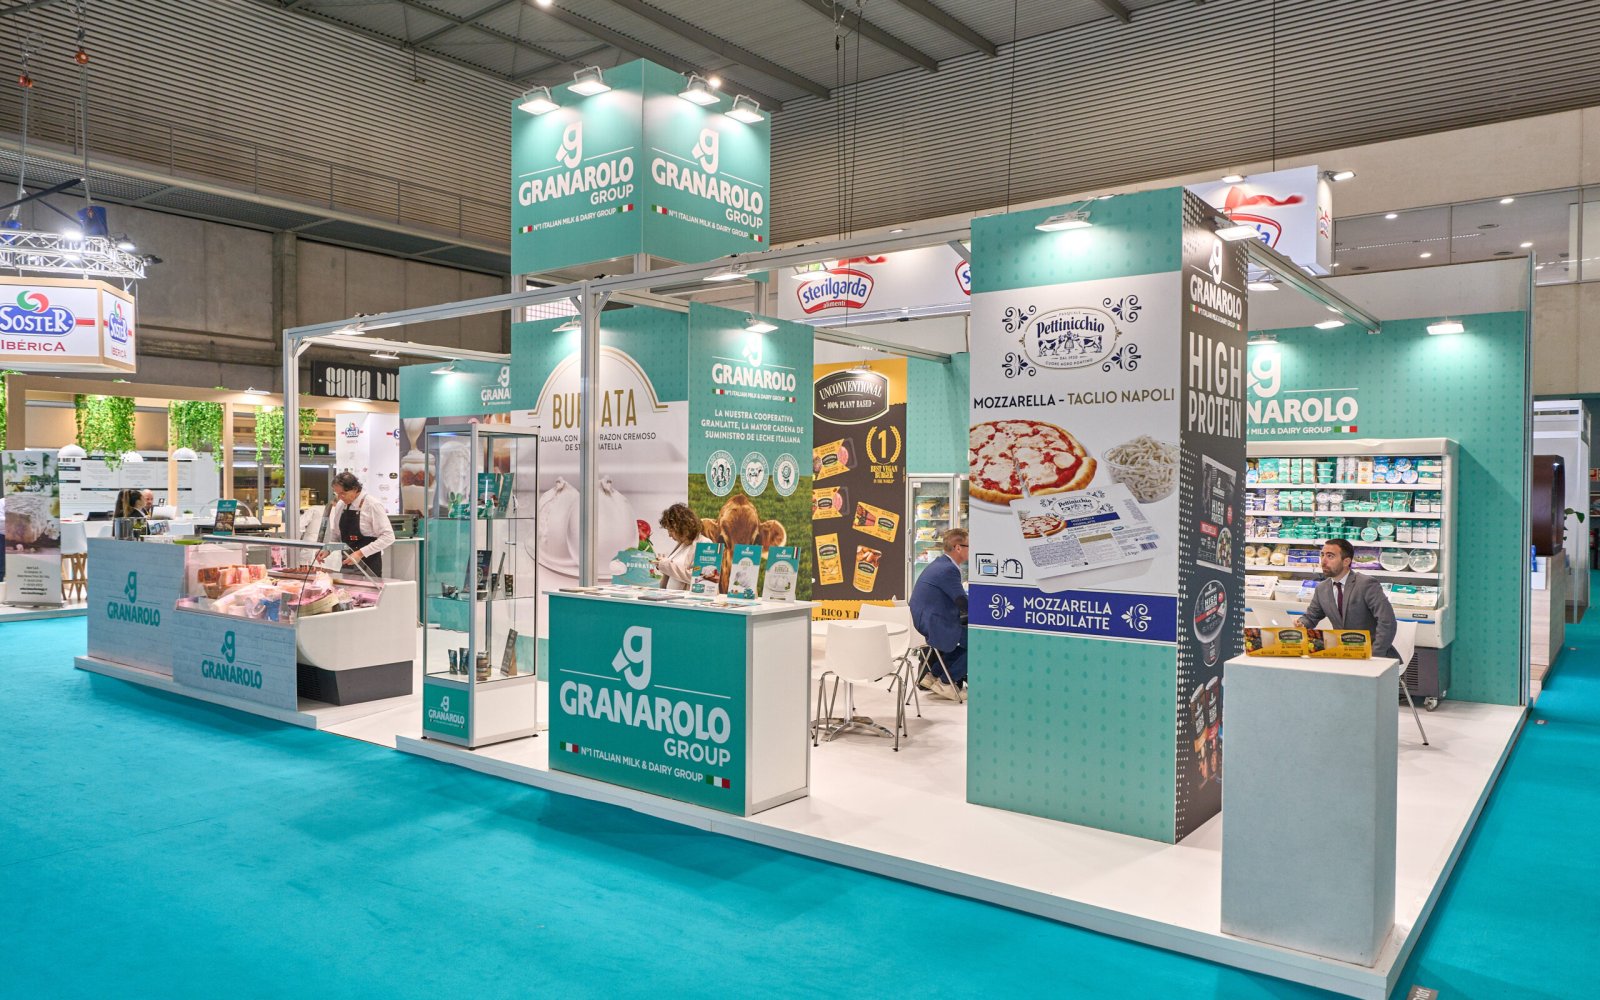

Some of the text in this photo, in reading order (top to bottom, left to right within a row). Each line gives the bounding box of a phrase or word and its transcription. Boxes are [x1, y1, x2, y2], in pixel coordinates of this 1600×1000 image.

[519, 156, 634, 206] GRANAROLO
[651, 157, 763, 214] GRANAROLO
[590, 183, 634, 205] GROUP
[542, 218, 562, 229] ITALIAN
[562, 215, 575, 225] MILK
[580, 211, 596, 221] DAIRY
[596, 207, 617, 217] GROUP
[678, 212, 699, 224] ITALIAN
[699, 218, 711, 228] MILK
[716, 223, 731, 233] DAIRY
[731, 228, 749, 238] GROUP
[725, 208, 763, 229] GROUP
[802, 277, 867, 304] sterilgarda
[1190, 274, 1242, 320] GRANAROLO
[823, 300, 846, 309] alimenti
[1036, 315, 1105, 338] Pettinicchio
[1188, 331, 1242, 399] HIGH
[712, 363, 796, 392] GRANAROLO
[481, 388, 511, 401] GRANA
[819, 380, 882, 400] UNCONVENTIONAL
[973, 394, 1056, 409] MOZZARELLA
[1067, 391, 1117, 405] TAGLIO
[1121, 388, 1175, 403] NAPOLI
[553, 389, 637, 429] BUATA
[840, 401, 855, 409] PLANT
[856, 400, 872, 408] BASED
[1188, 390, 1241, 438] PROTEIN
[1247, 396, 1358, 424] NAROLO
[701, 419, 740, 430] GRANLATTE,
[750, 423, 772, 431] MAYOR
[772, 425, 795, 434] CADENA
[796, 426, 804, 434] DE
[714, 409, 794, 423] LA NUESTRA COOPERATIVA
[564, 434, 578, 442] CON
[623, 432, 657, 440] CREMOSO
[705, 430, 801, 443] SUMINISTRO DE LECHE ITALIANA
[1270, 427, 1276, 435] &
[1302, 426, 1331, 434] GROUP
[565, 443, 573, 451] DE
[878, 430, 887, 458] 1
[1211, 499, 1224, 516] HIGH
[107, 602, 160, 627] GRANAROLO
[821, 608, 842, 617] RICO
[845, 610, 851, 619] Y
[1023, 596, 1112, 615] MOZZARELLA
[1025, 612, 1110, 630] FIORDILATTE
[201, 660, 262, 689] GRANAROLO
[428, 709, 465, 725] GRANAROLO
[560, 681, 731, 744] GRANAROLO
[664, 738, 731, 767] GROUP
[593, 748, 621, 764] ITALIAN
[622, 755, 640, 768] MILK
[642, 760, 647, 770] &
[649, 762, 672, 776] DAIRY
[674, 768, 703, 782] GROUP
